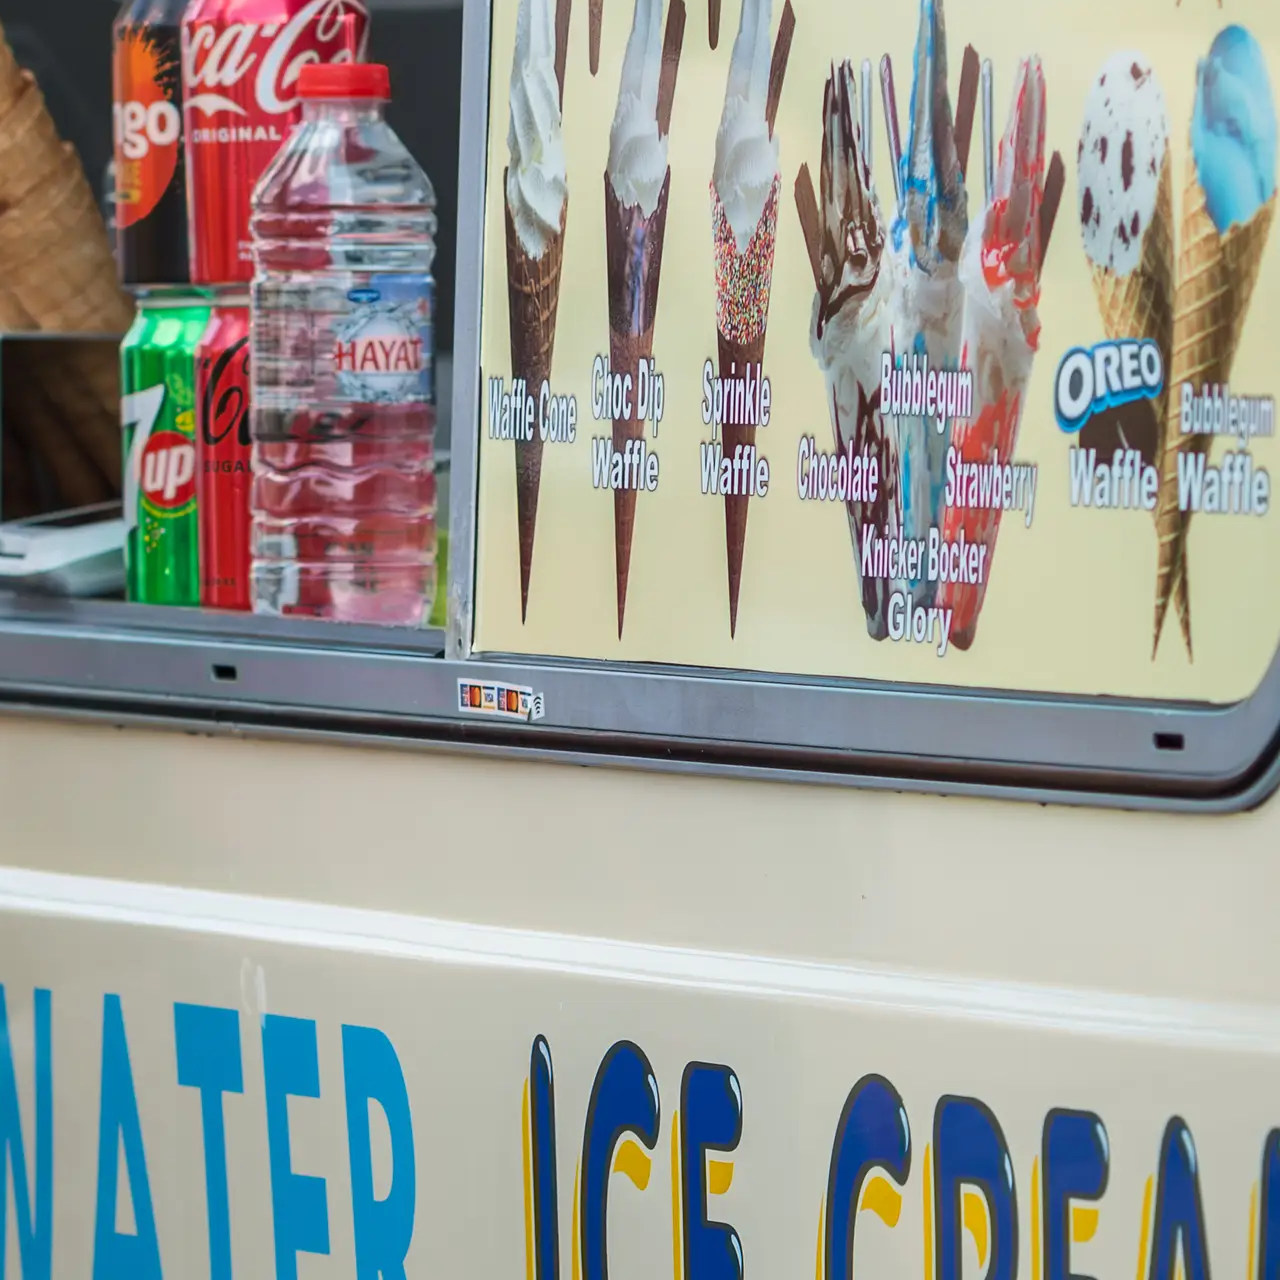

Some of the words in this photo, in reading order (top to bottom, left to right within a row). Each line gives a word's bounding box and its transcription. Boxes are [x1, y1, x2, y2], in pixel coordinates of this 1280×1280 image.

[192, 125, 281, 144] ORIGINAL
[336, 337, 424, 372] HAYAT
[1056, 341, 1163, 420] OREO
[488, 377, 534, 442] Waffle
[539, 379, 577, 443] Cone
[591, 355, 633, 421] Choc
[639, 356, 665, 437] Dip
[702, 359, 771, 440] Sprinkle
[880, 352, 974, 435] Bubblegum
[1180, 381, 1275, 450] Bubblegum
[202, 458, 253, 475] SUGA
[591, 437, 660, 491] Waffle
[699, 442, 770, 497] Waffle
[797, 435, 879, 504] Chocolate
[944, 445, 1038, 528] Strawberry
[1069, 446, 1159, 510] Waffle
[1177, 450, 1270, 516] Waffle
[861, 523, 925, 581] Knicker
[927, 526, 988, 585] Bocker
[887, 591, 953, 657] Glory
[523, 1034, 744, 1280] ICE
